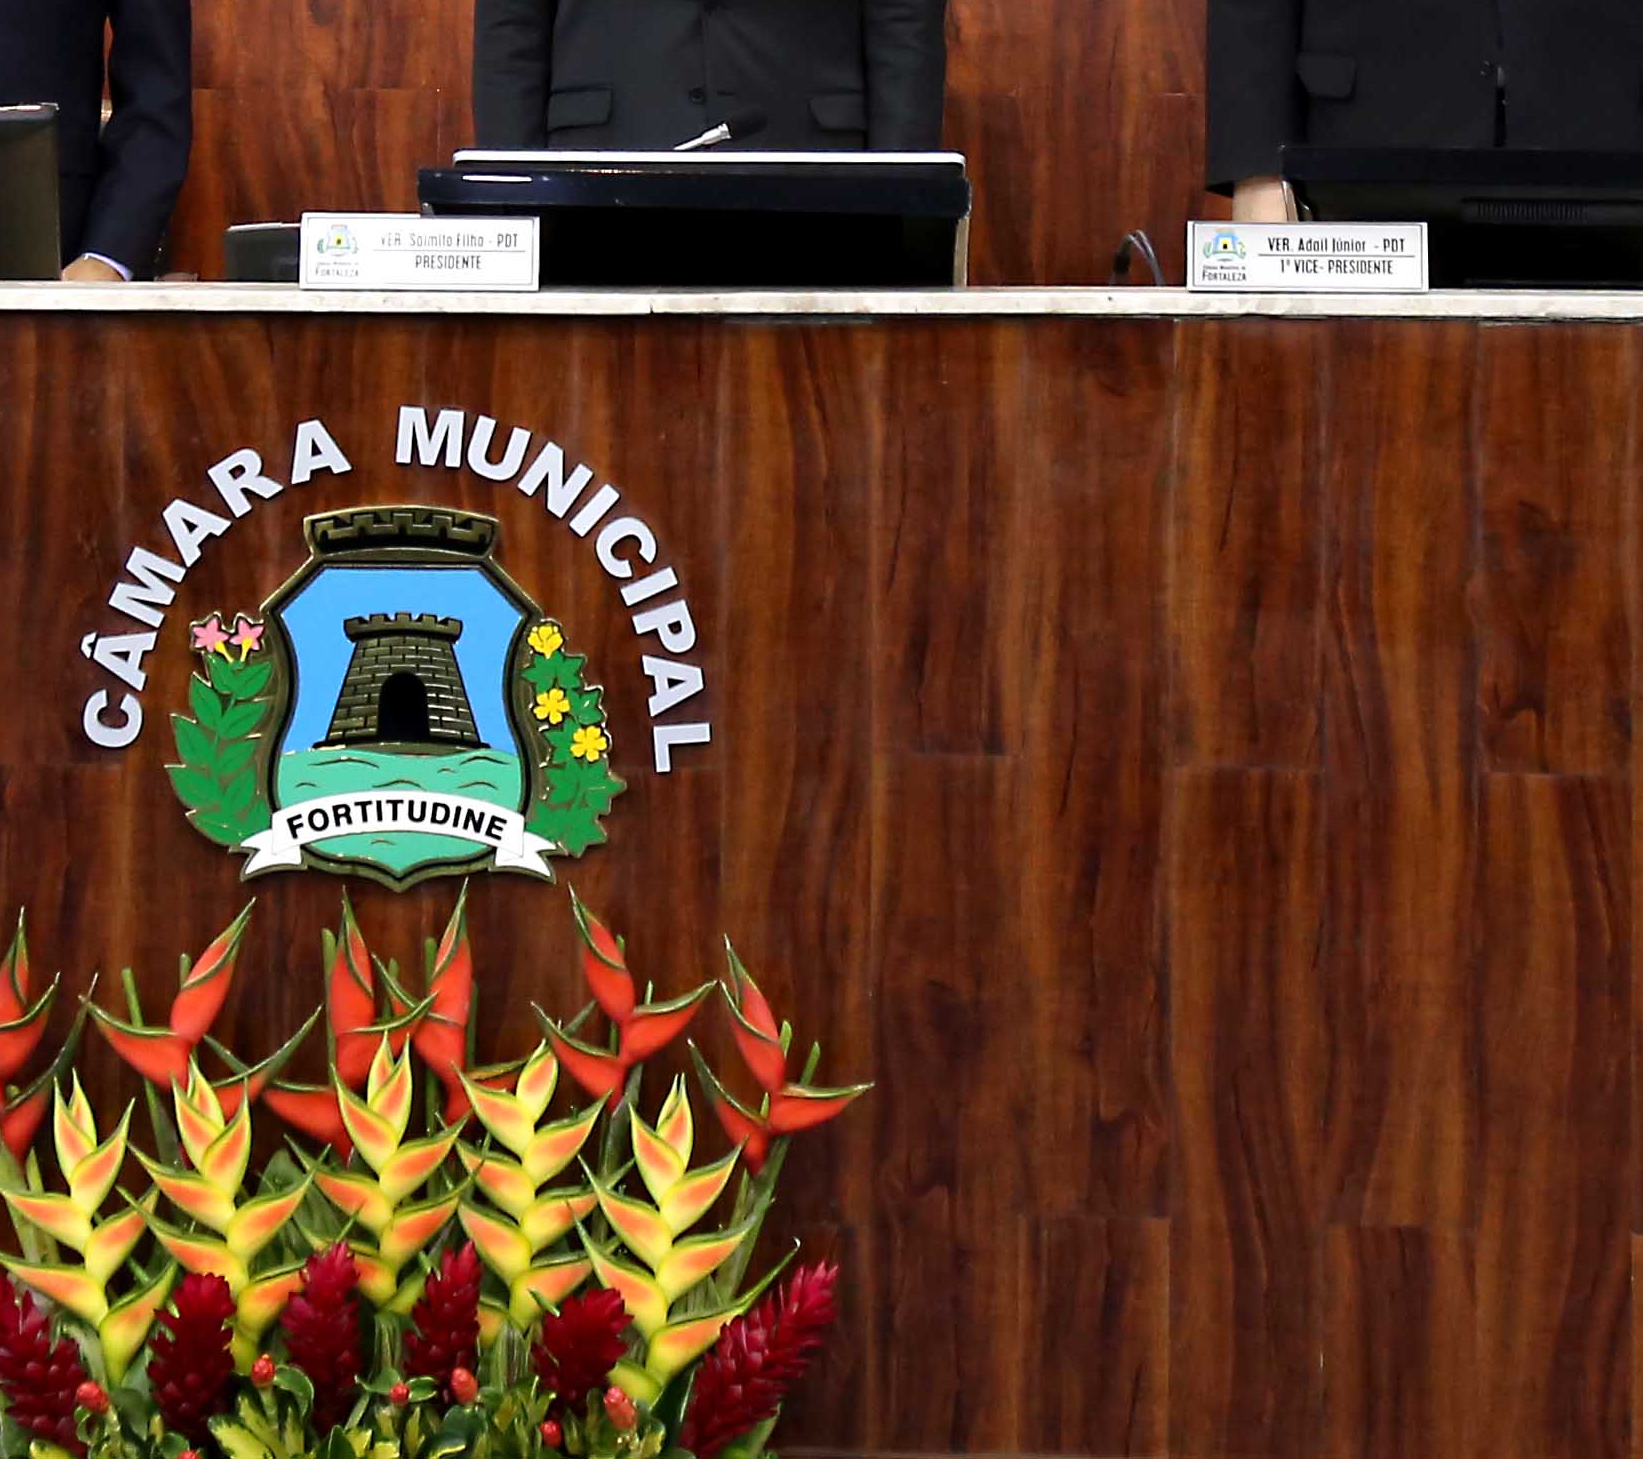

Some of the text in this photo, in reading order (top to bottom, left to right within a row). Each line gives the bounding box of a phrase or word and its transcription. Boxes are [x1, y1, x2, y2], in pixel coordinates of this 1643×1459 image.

[456, 232, 485, 248] Filho
[497, 232, 519, 248] PDT
[1267, 237, 1294, 253] VER.
[1298, 237, 1328, 253] Adail
[1332, 236, 1366, 254] Júnior
[1383, 238, 1406, 253] PDT
[415, 254, 483, 270] PRESIDENTE
[1328, 259, 1394, 275] PRESIDENTE
[1201, 268, 1247, 282] FORTALEZA
[81, 405, 711, 773] CÂMARA MUNICIPAL
[286, 799, 508, 840] FORTITUDINE
